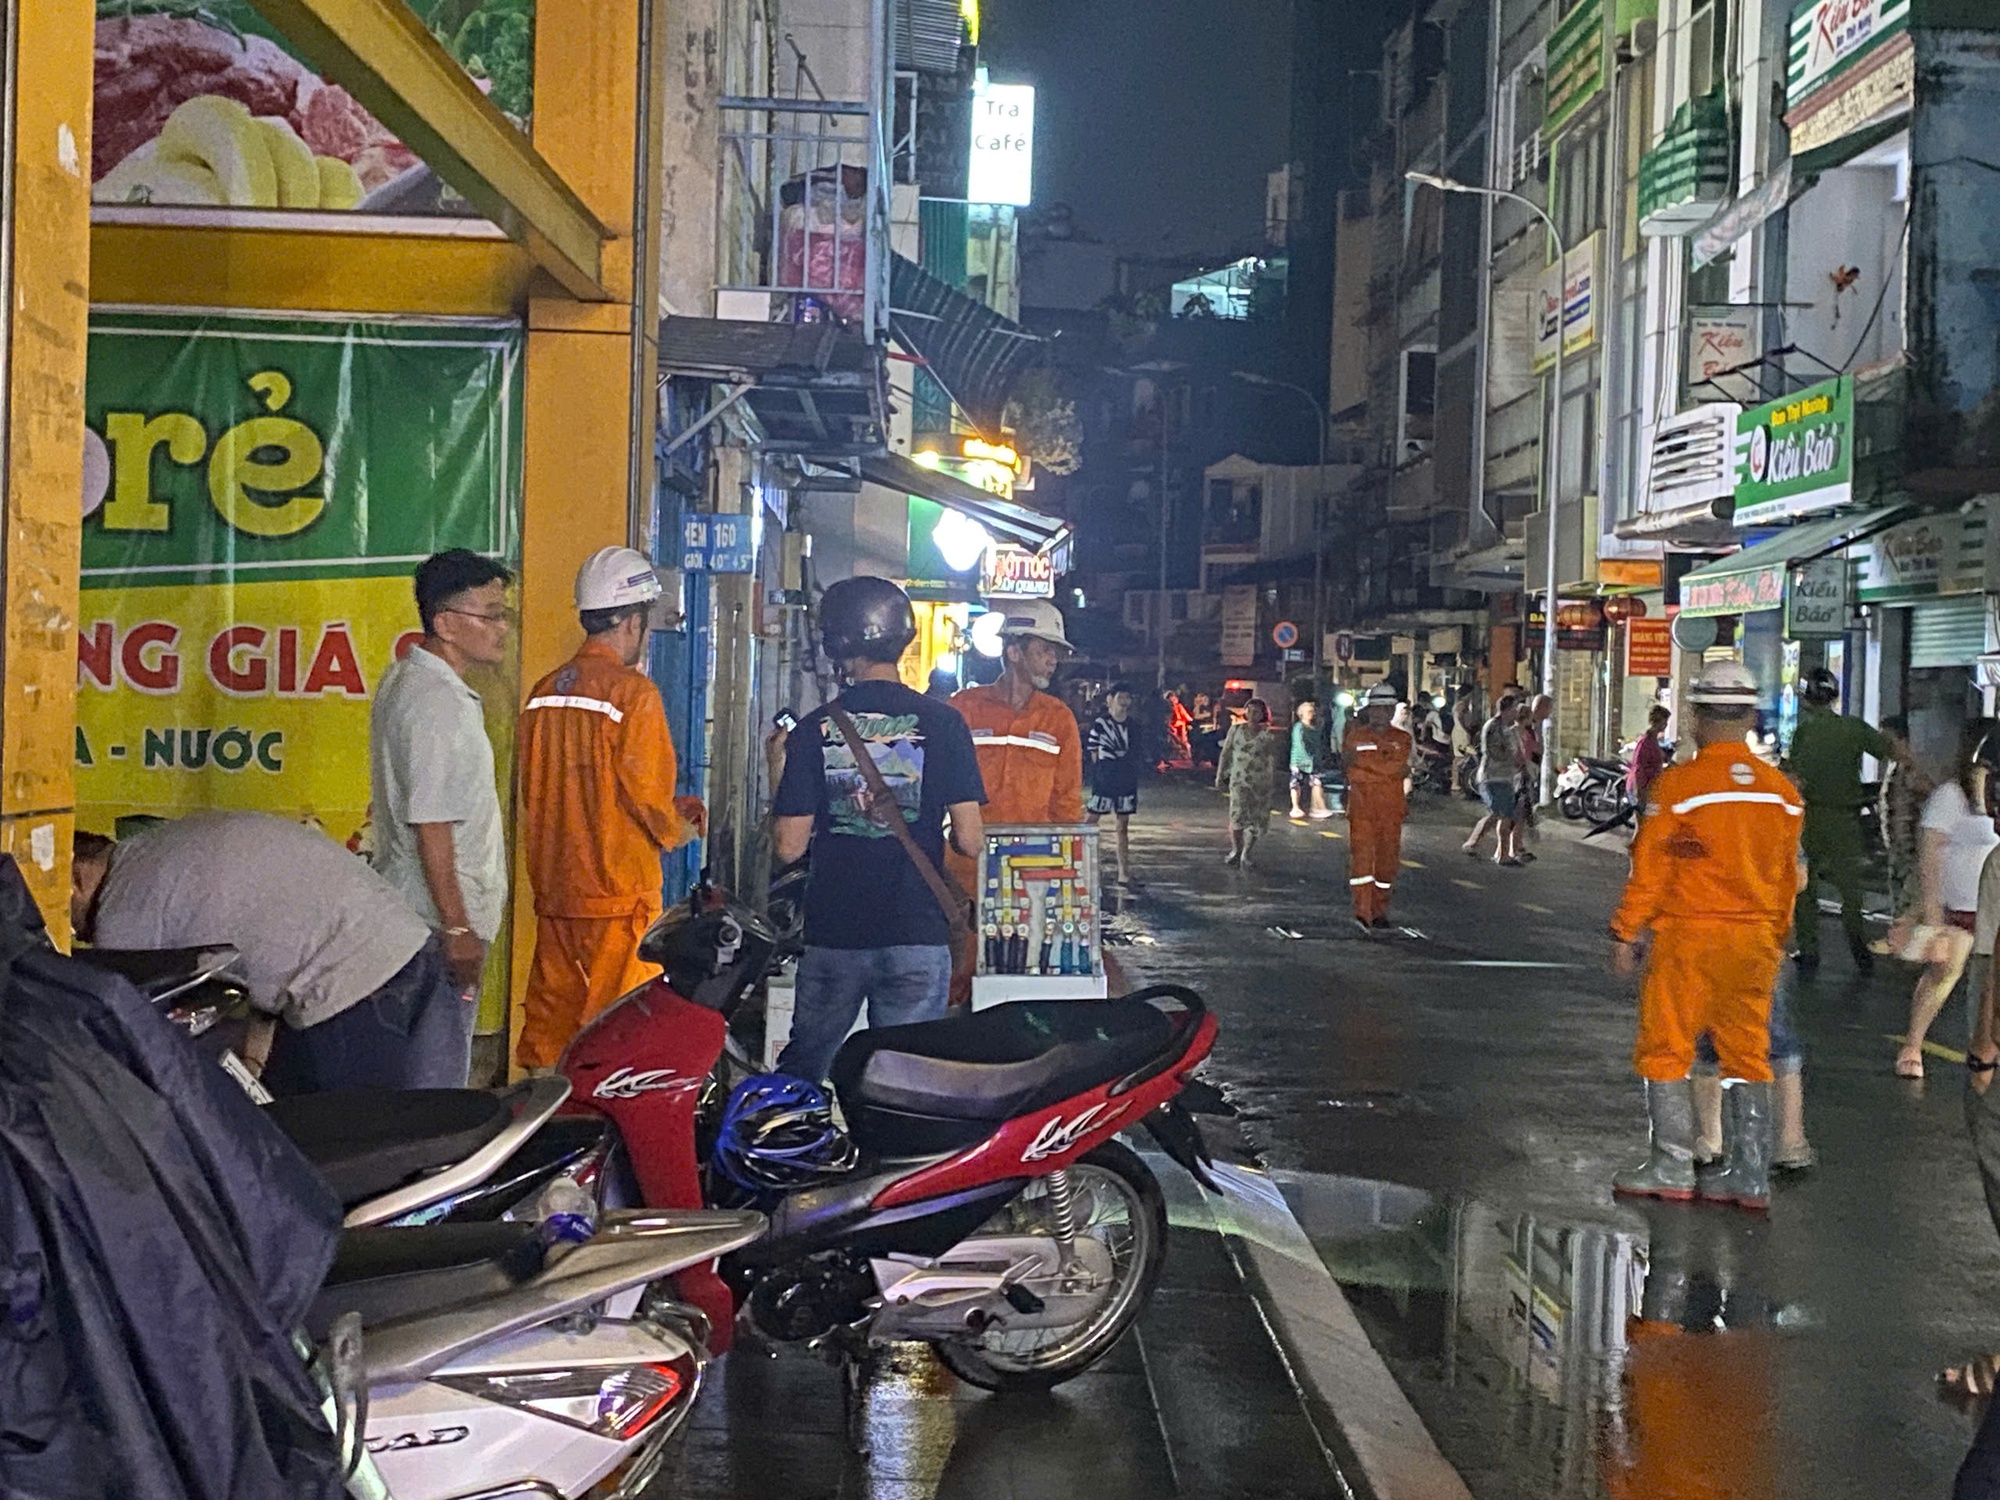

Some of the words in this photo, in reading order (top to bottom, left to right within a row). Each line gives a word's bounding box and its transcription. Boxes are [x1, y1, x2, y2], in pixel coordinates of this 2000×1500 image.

[713, 522, 737, 549] 160
[210, 622, 367, 696] GIÁ
[144, 726, 284, 772] NƯỚC
[362, 1424, 471, 1453] EAD
